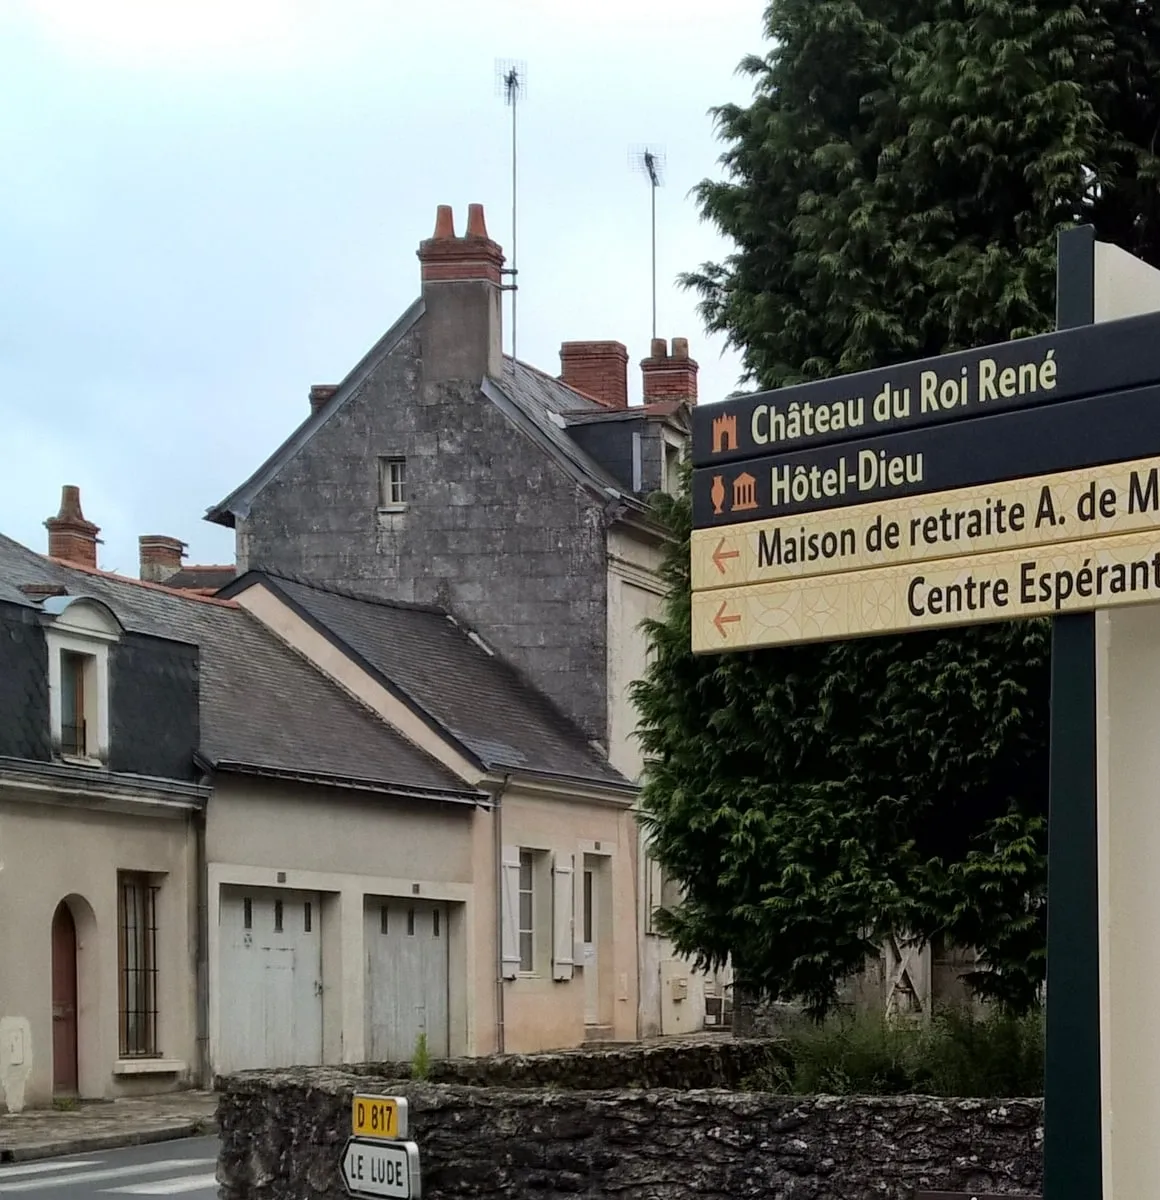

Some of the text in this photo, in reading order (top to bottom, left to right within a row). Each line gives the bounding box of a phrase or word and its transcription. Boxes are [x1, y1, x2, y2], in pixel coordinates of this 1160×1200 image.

[751, 349, 1057, 445] Château du Roi René
[770, 449, 924, 506] Hôtel-Dieu
[757, 525, 856, 568] Maison
[866, 513, 900, 554] de
[909, 497, 1025, 546] retraite
[1034, 485, 1066, 529] A.
[1077, 481, 1116, 522] de
[907, 573, 1009, 618] Centre
[358, 1103, 392, 1132] D 817
[351, 1154, 403, 1187] LE LUDE
